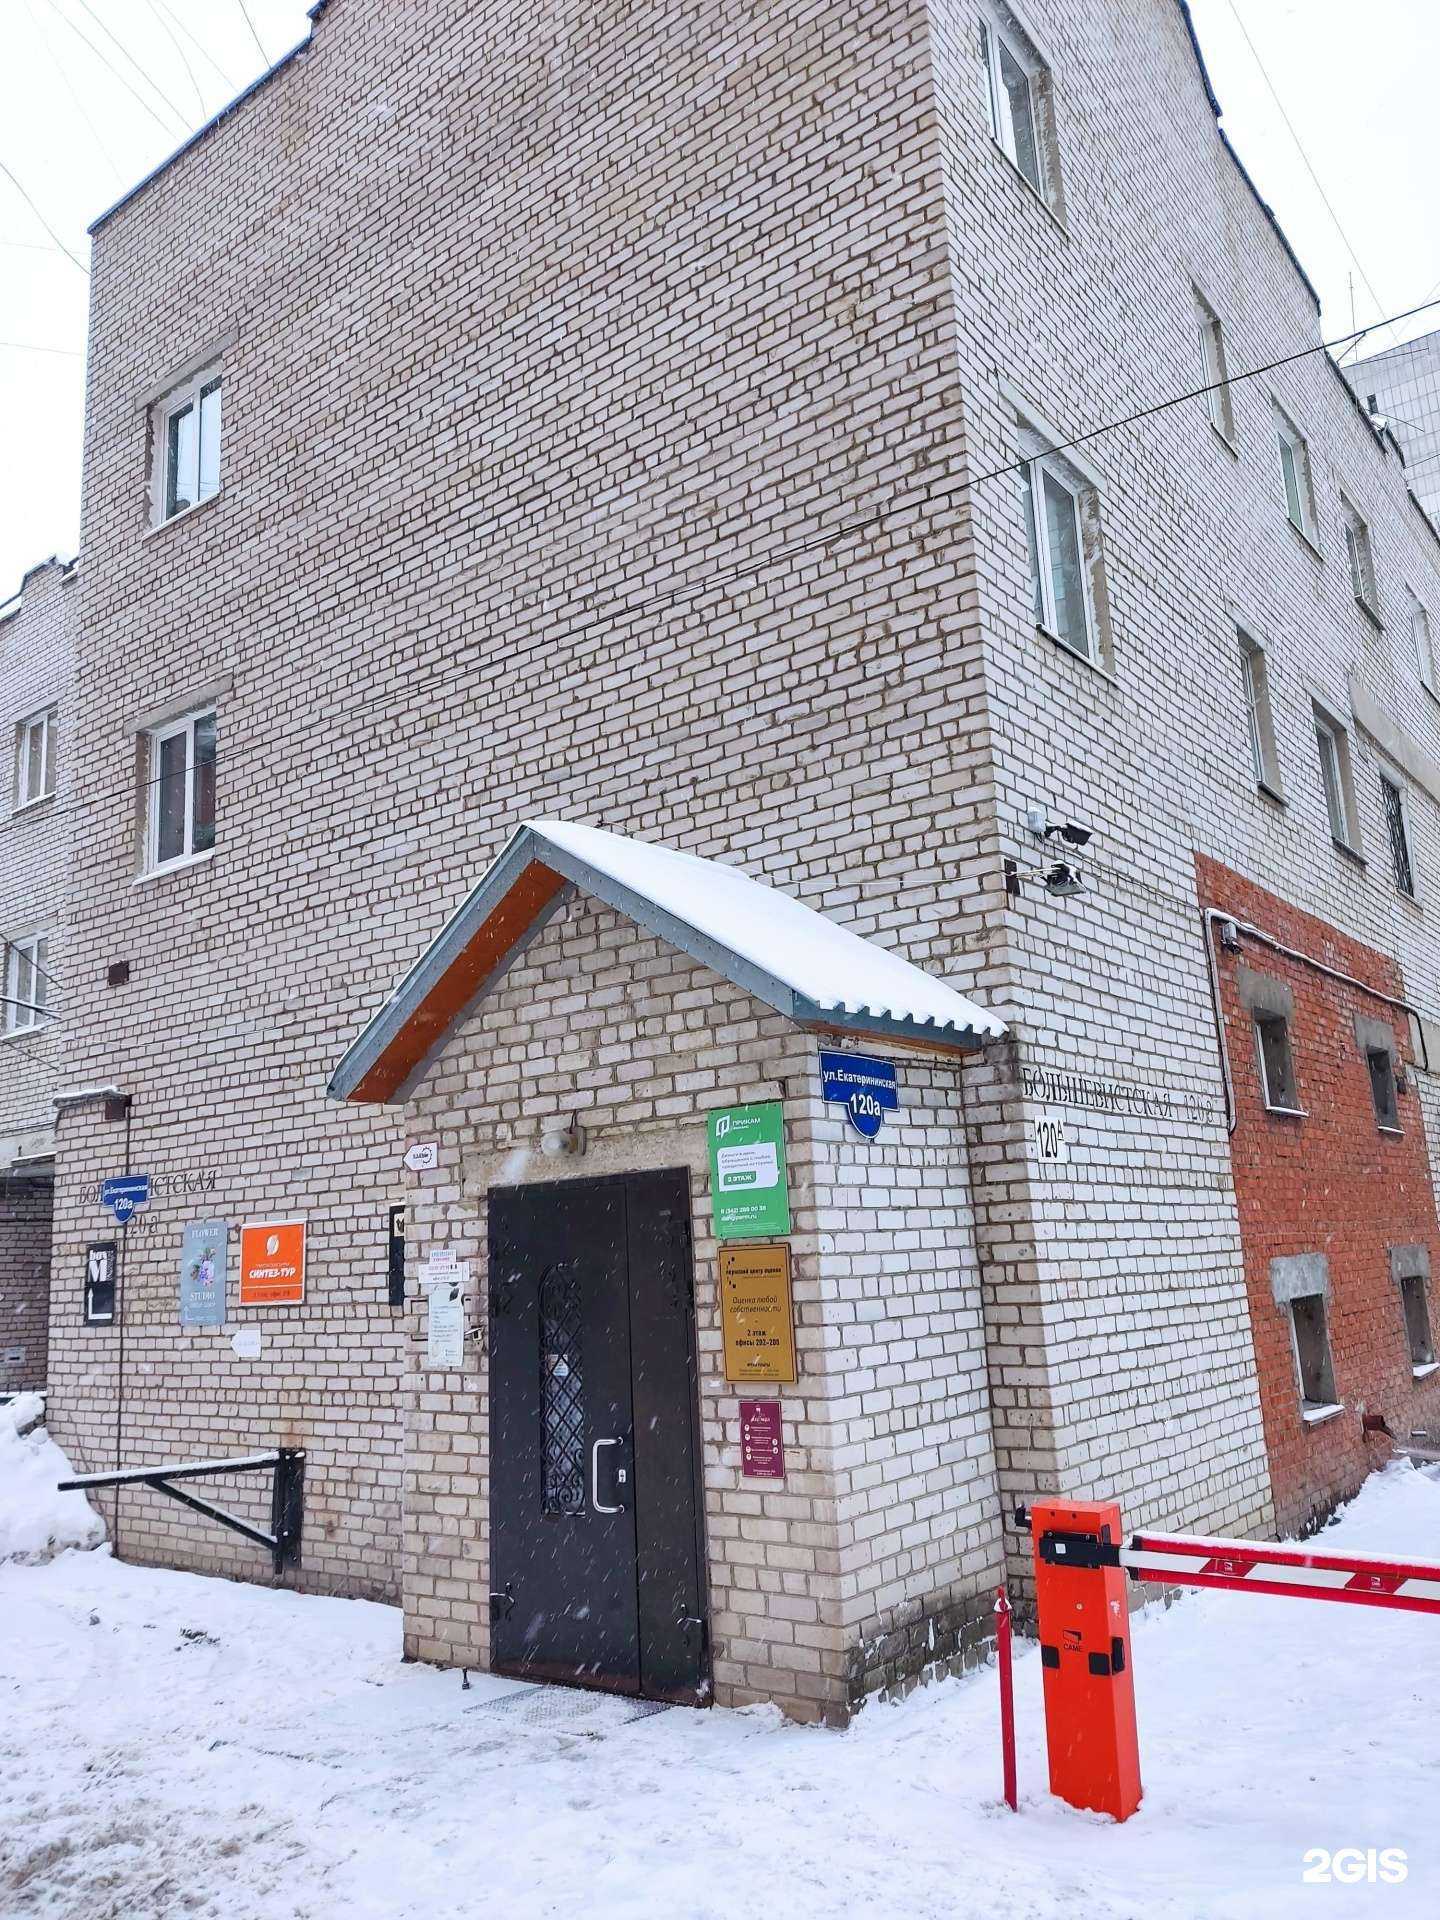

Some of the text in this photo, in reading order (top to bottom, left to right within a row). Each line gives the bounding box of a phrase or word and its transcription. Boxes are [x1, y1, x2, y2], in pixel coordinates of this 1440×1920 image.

[823, 1069, 896, 1090] ул.Екатерининская
[850, 1093, 881, 1116] 120а
[191, 1228, 219, 1239] FLOWER
